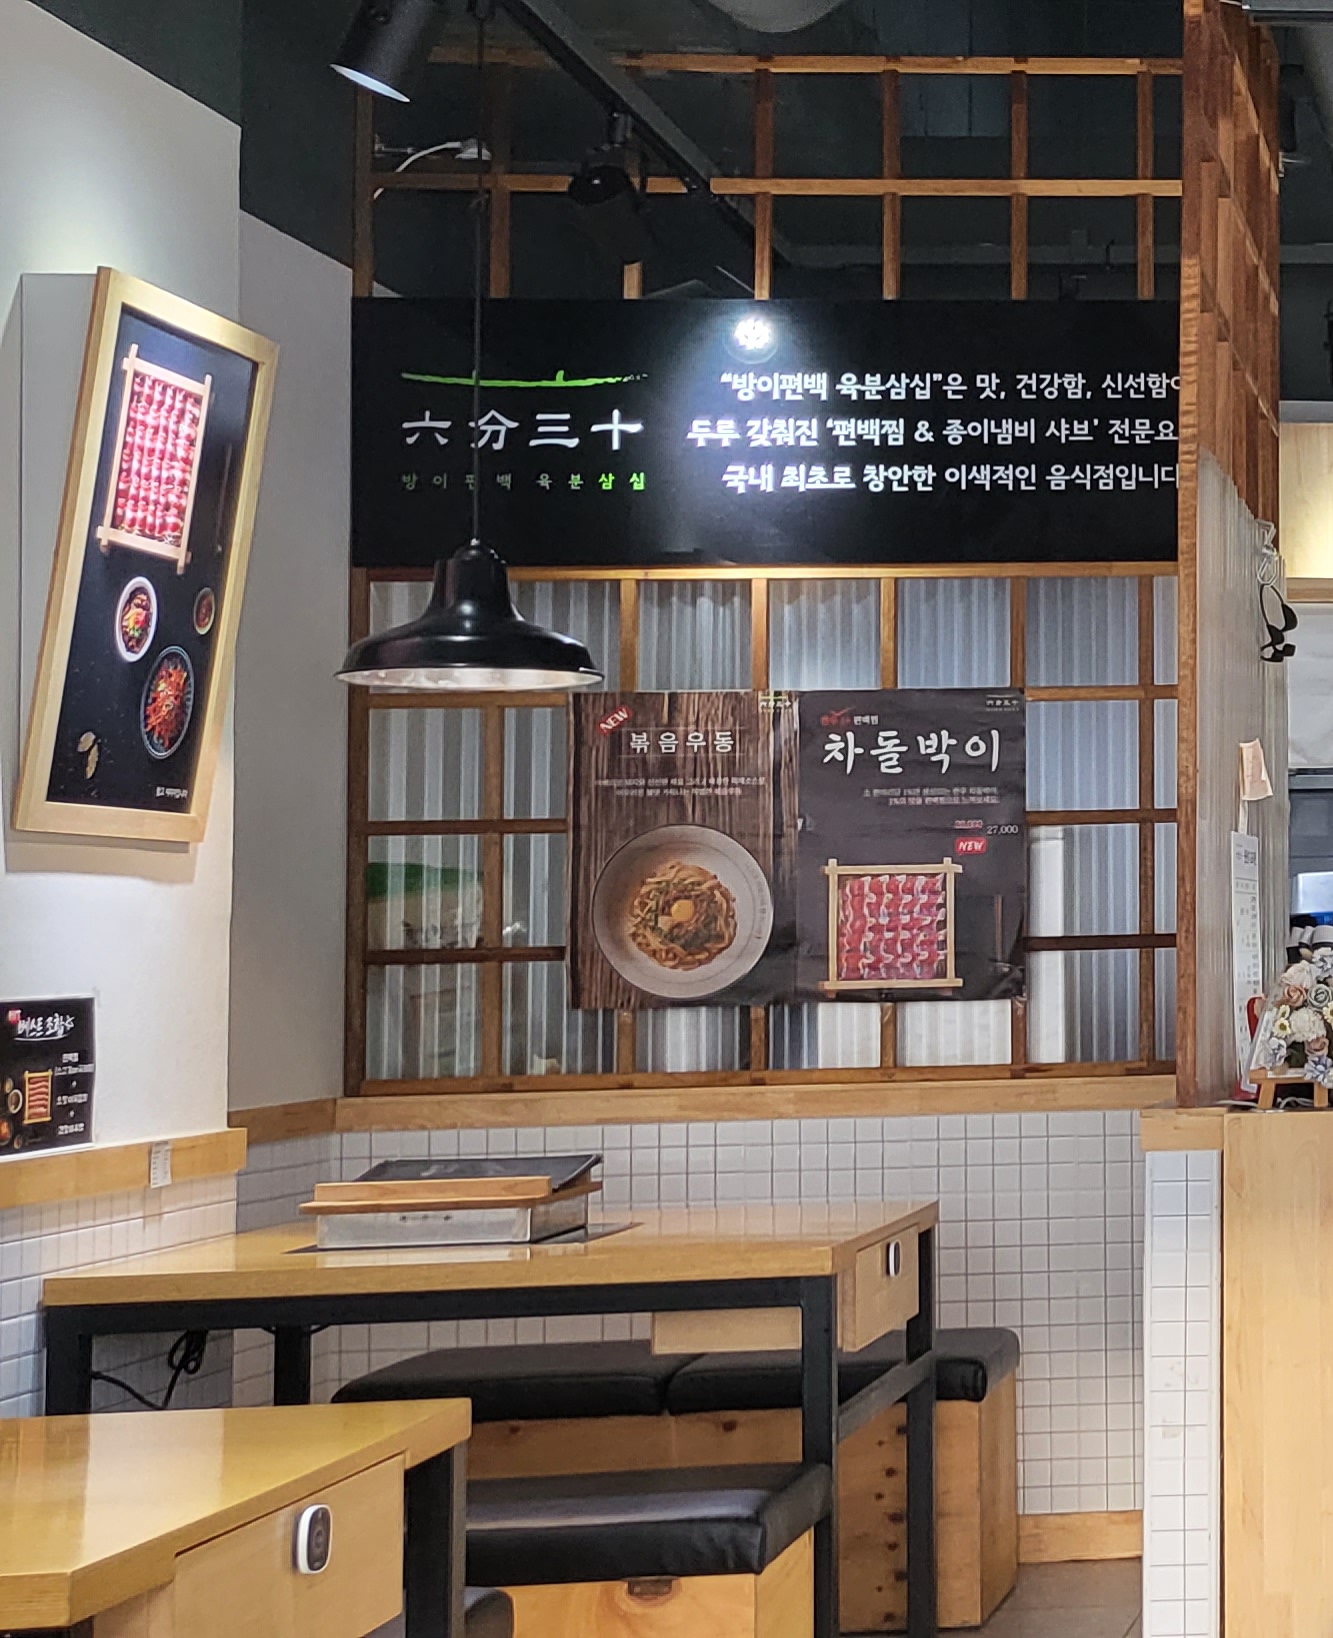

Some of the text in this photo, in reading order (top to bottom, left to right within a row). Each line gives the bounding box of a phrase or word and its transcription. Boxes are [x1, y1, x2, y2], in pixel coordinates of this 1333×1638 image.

[720, 372, 828, 401] “방이편백
[835, 373, 968, 400] 육분삼십”은
[975, 372, 1006, 400] 맛,
[1015, 372, 1093, 400] 건강함,
[401, 408, 645, 451] 六分三十
[686, 417, 741, 448] 두루
[746, 417, 820, 448] 갖춰진
[826, 417, 905, 447] ‘편백찜
[914, 420, 935, 443] &
[942, 418, 1036, 446] 종이냄비
[1044, 418, 1099, 444] 샤브’
[722, 463, 775, 493] 국내
[780, 463, 857, 492] 최초로
[863, 463, 937, 492] 창안한
[944, 463, 1037, 492] 이색적인
[599, 707, 630, 733] NEW
[629, 730, 734, 754] 볶음우동
[823, 729, 1000, 775] 차돌박이
[986, 824, 1019, 835] 27,000
[957, 840, 984, 852] NEW
